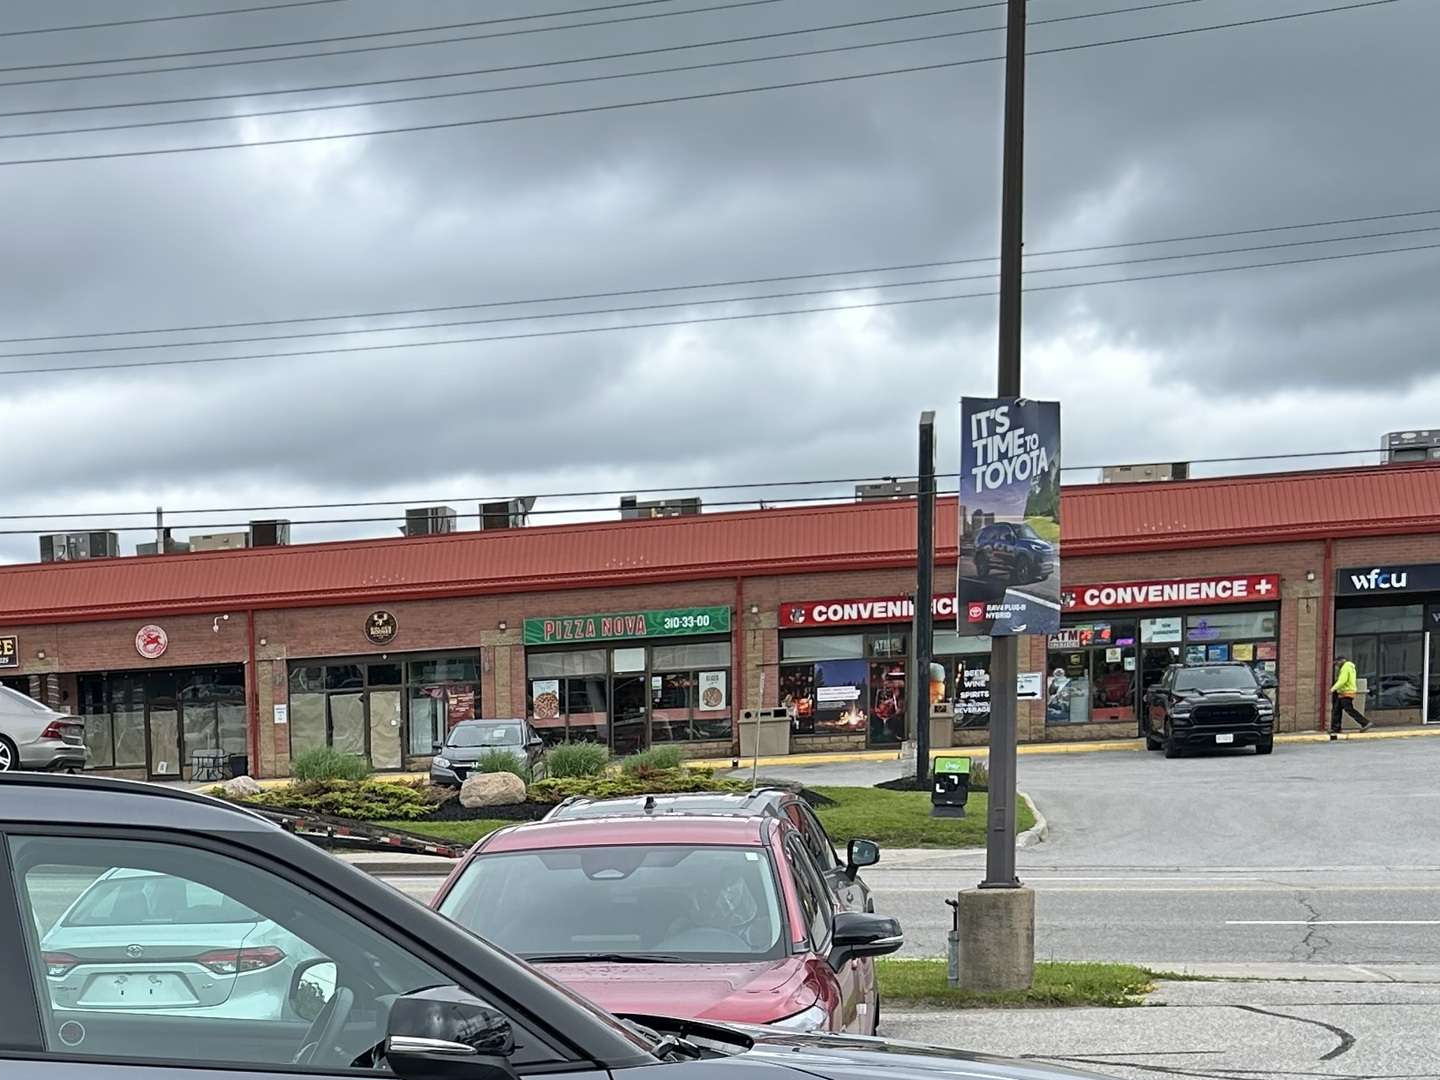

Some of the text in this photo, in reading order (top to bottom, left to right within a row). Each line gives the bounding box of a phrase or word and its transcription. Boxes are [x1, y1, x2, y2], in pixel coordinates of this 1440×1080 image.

[970, 406, 1010, 440] IT'S
[972, 428, 1039, 466] TIME TO
[971, 447, 1049, 494] TOYOTA
[1351, 568, 1407, 590] wfcu
[1084, 580, 1247, 606] CONVENIENCE
[543, 614, 710, 641] PIZZA NOVA 310-33-00
[1049, 630, 1078, 641] ATM
[964, 669, 985, 677] BEER
[964, 680, 986, 688] WINE
[960, 690, 990, 699] SPIRITS
